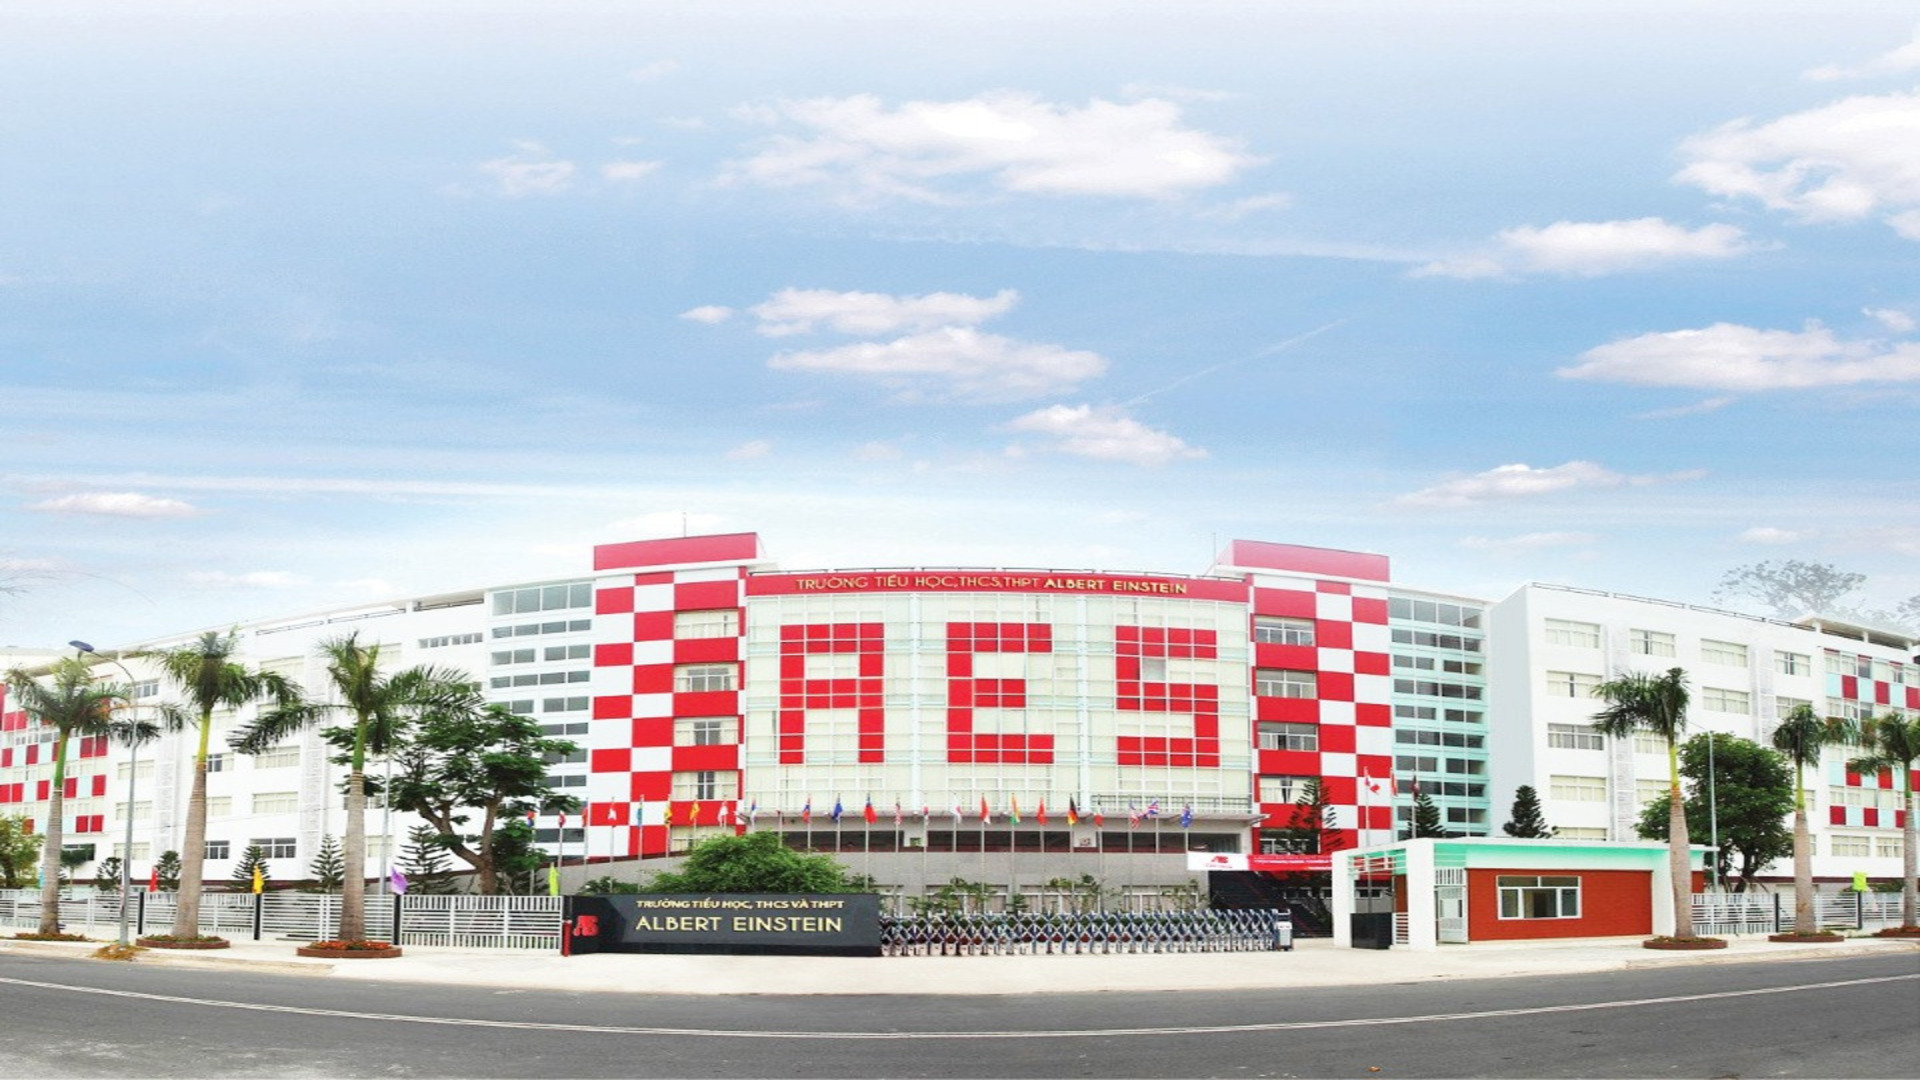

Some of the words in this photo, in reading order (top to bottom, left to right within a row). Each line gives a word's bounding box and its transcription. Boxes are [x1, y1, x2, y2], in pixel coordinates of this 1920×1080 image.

[1044, 578, 1105, 590] ALBERT
[1113, 580, 1187, 594] EINSTEIN
[756, 900, 789, 909] THCS
[791, 898, 809, 909] VÀ
[809, 900, 845, 909] THPT
[635, 915, 722, 931] ALBERT
[733, 916, 842, 932] EINSTEIN
